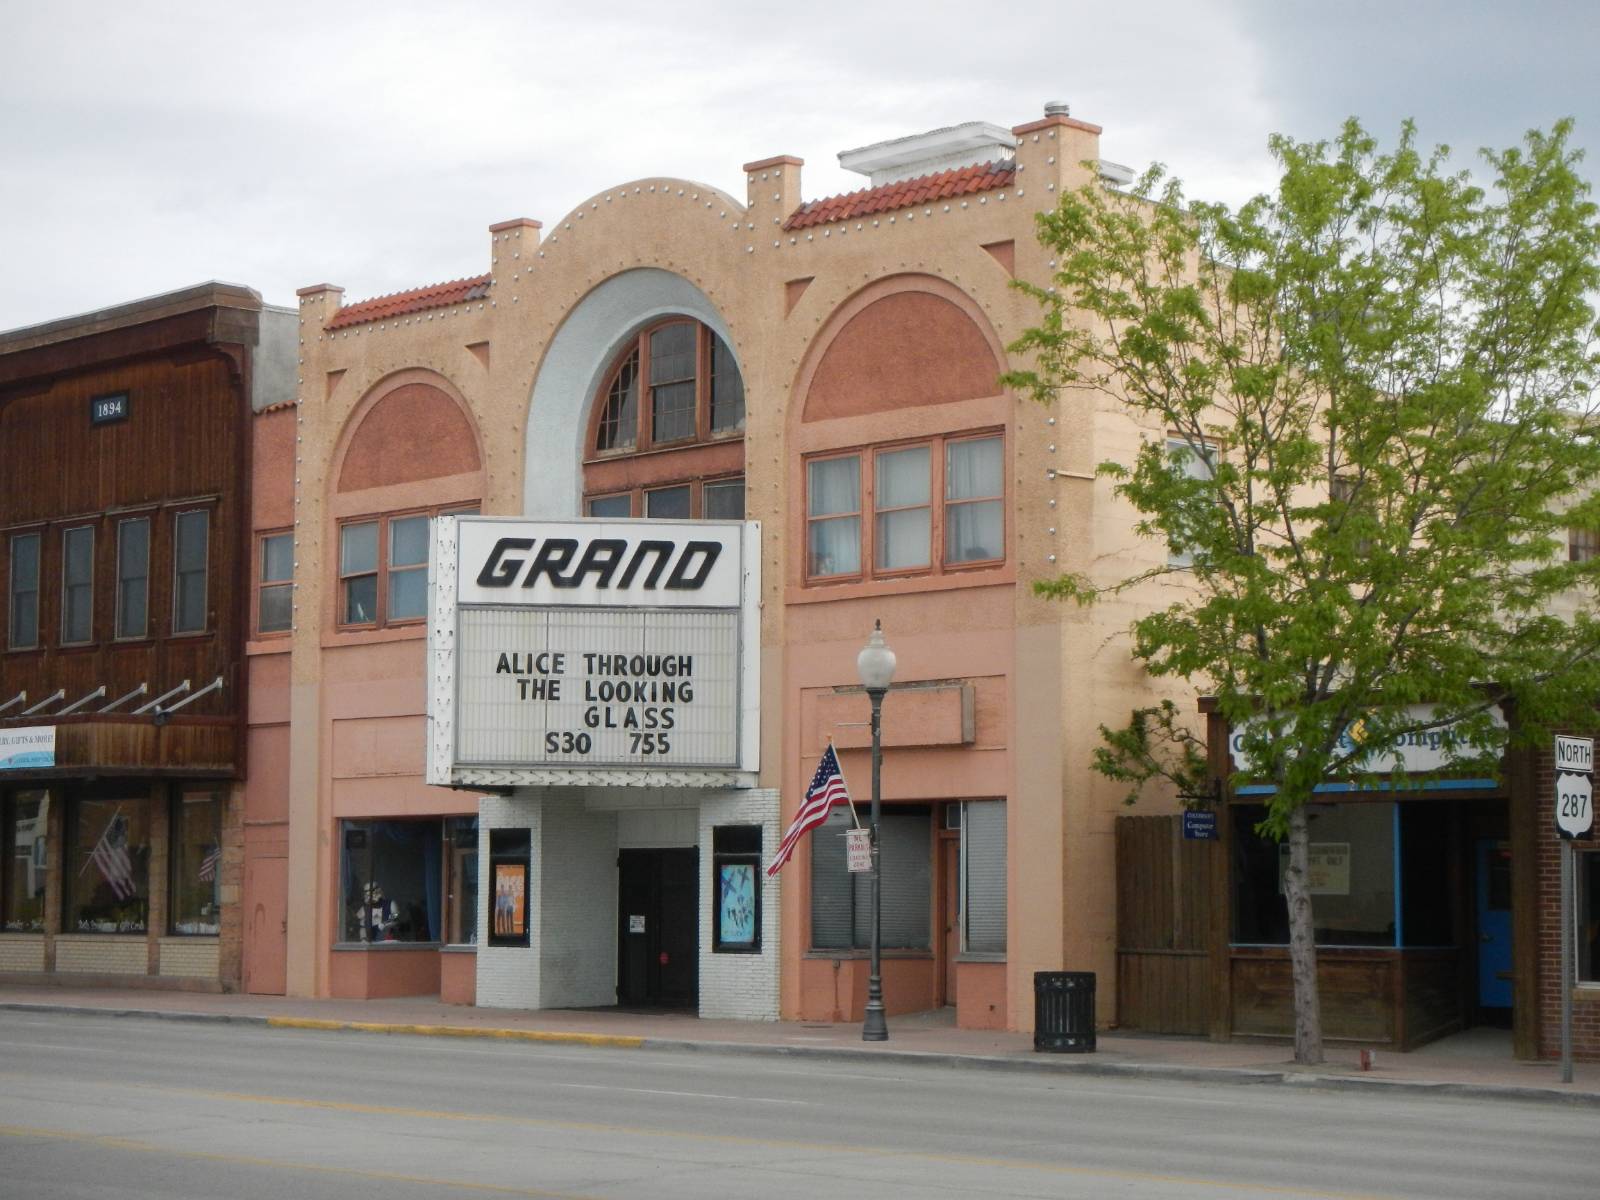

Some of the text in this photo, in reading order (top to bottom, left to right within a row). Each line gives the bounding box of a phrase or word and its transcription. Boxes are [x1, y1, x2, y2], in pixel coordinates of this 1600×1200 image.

[98, 401, 121, 417] 1894
[477, 537, 722, 590] GRAND
[496, 652, 693, 677] ALICE THROUGH
[517, 679, 694, 703] THE LOOKING
[585, 706, 675, 729] GLASS
[630, 732, 671, 756] 755
[1558, 741, 1591, 764] NORTH
[1562, 794, 1588, 818] 287
